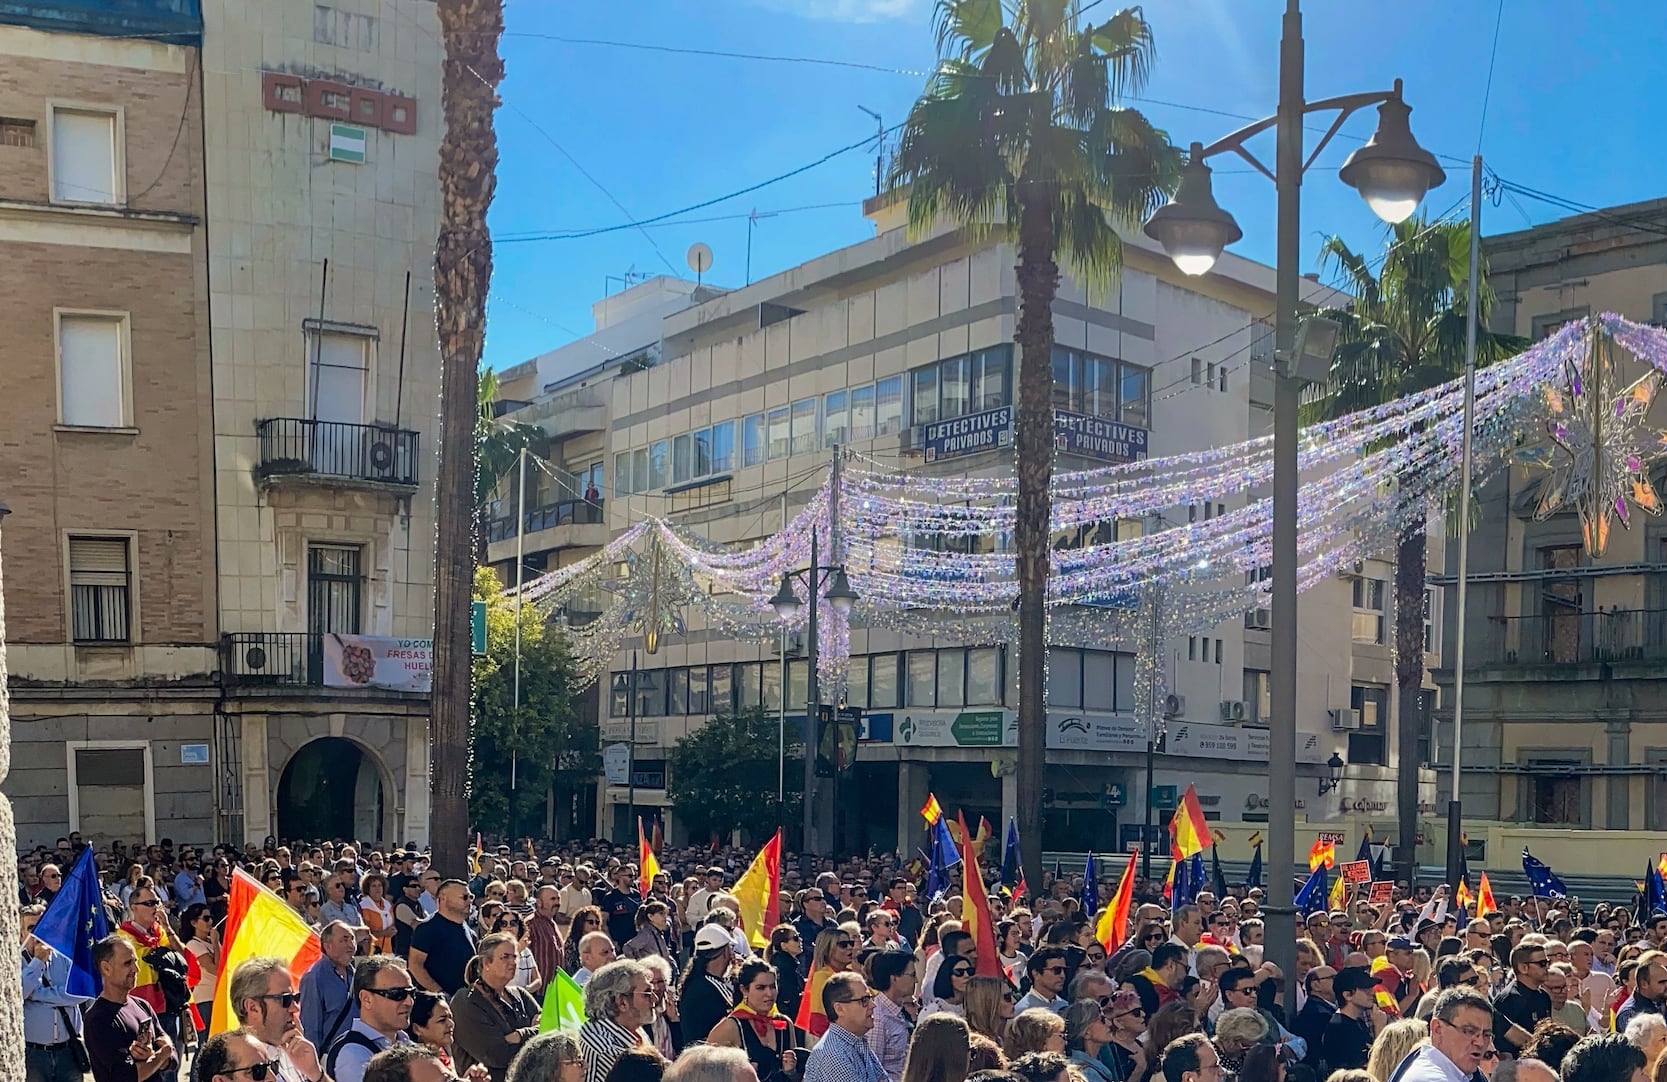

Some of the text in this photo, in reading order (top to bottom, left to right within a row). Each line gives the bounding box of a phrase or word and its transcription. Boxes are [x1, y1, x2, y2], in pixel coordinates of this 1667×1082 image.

[928, 410, 1008, 441] DETECTIVES
[1058, 413, 1145, 446] DETECTIVES
[944, 429, 993, 453] PRIVADOS
[1076, 433, 1129, 457] PRIVADOS
[387, 650, 425, 660] FRESAS
